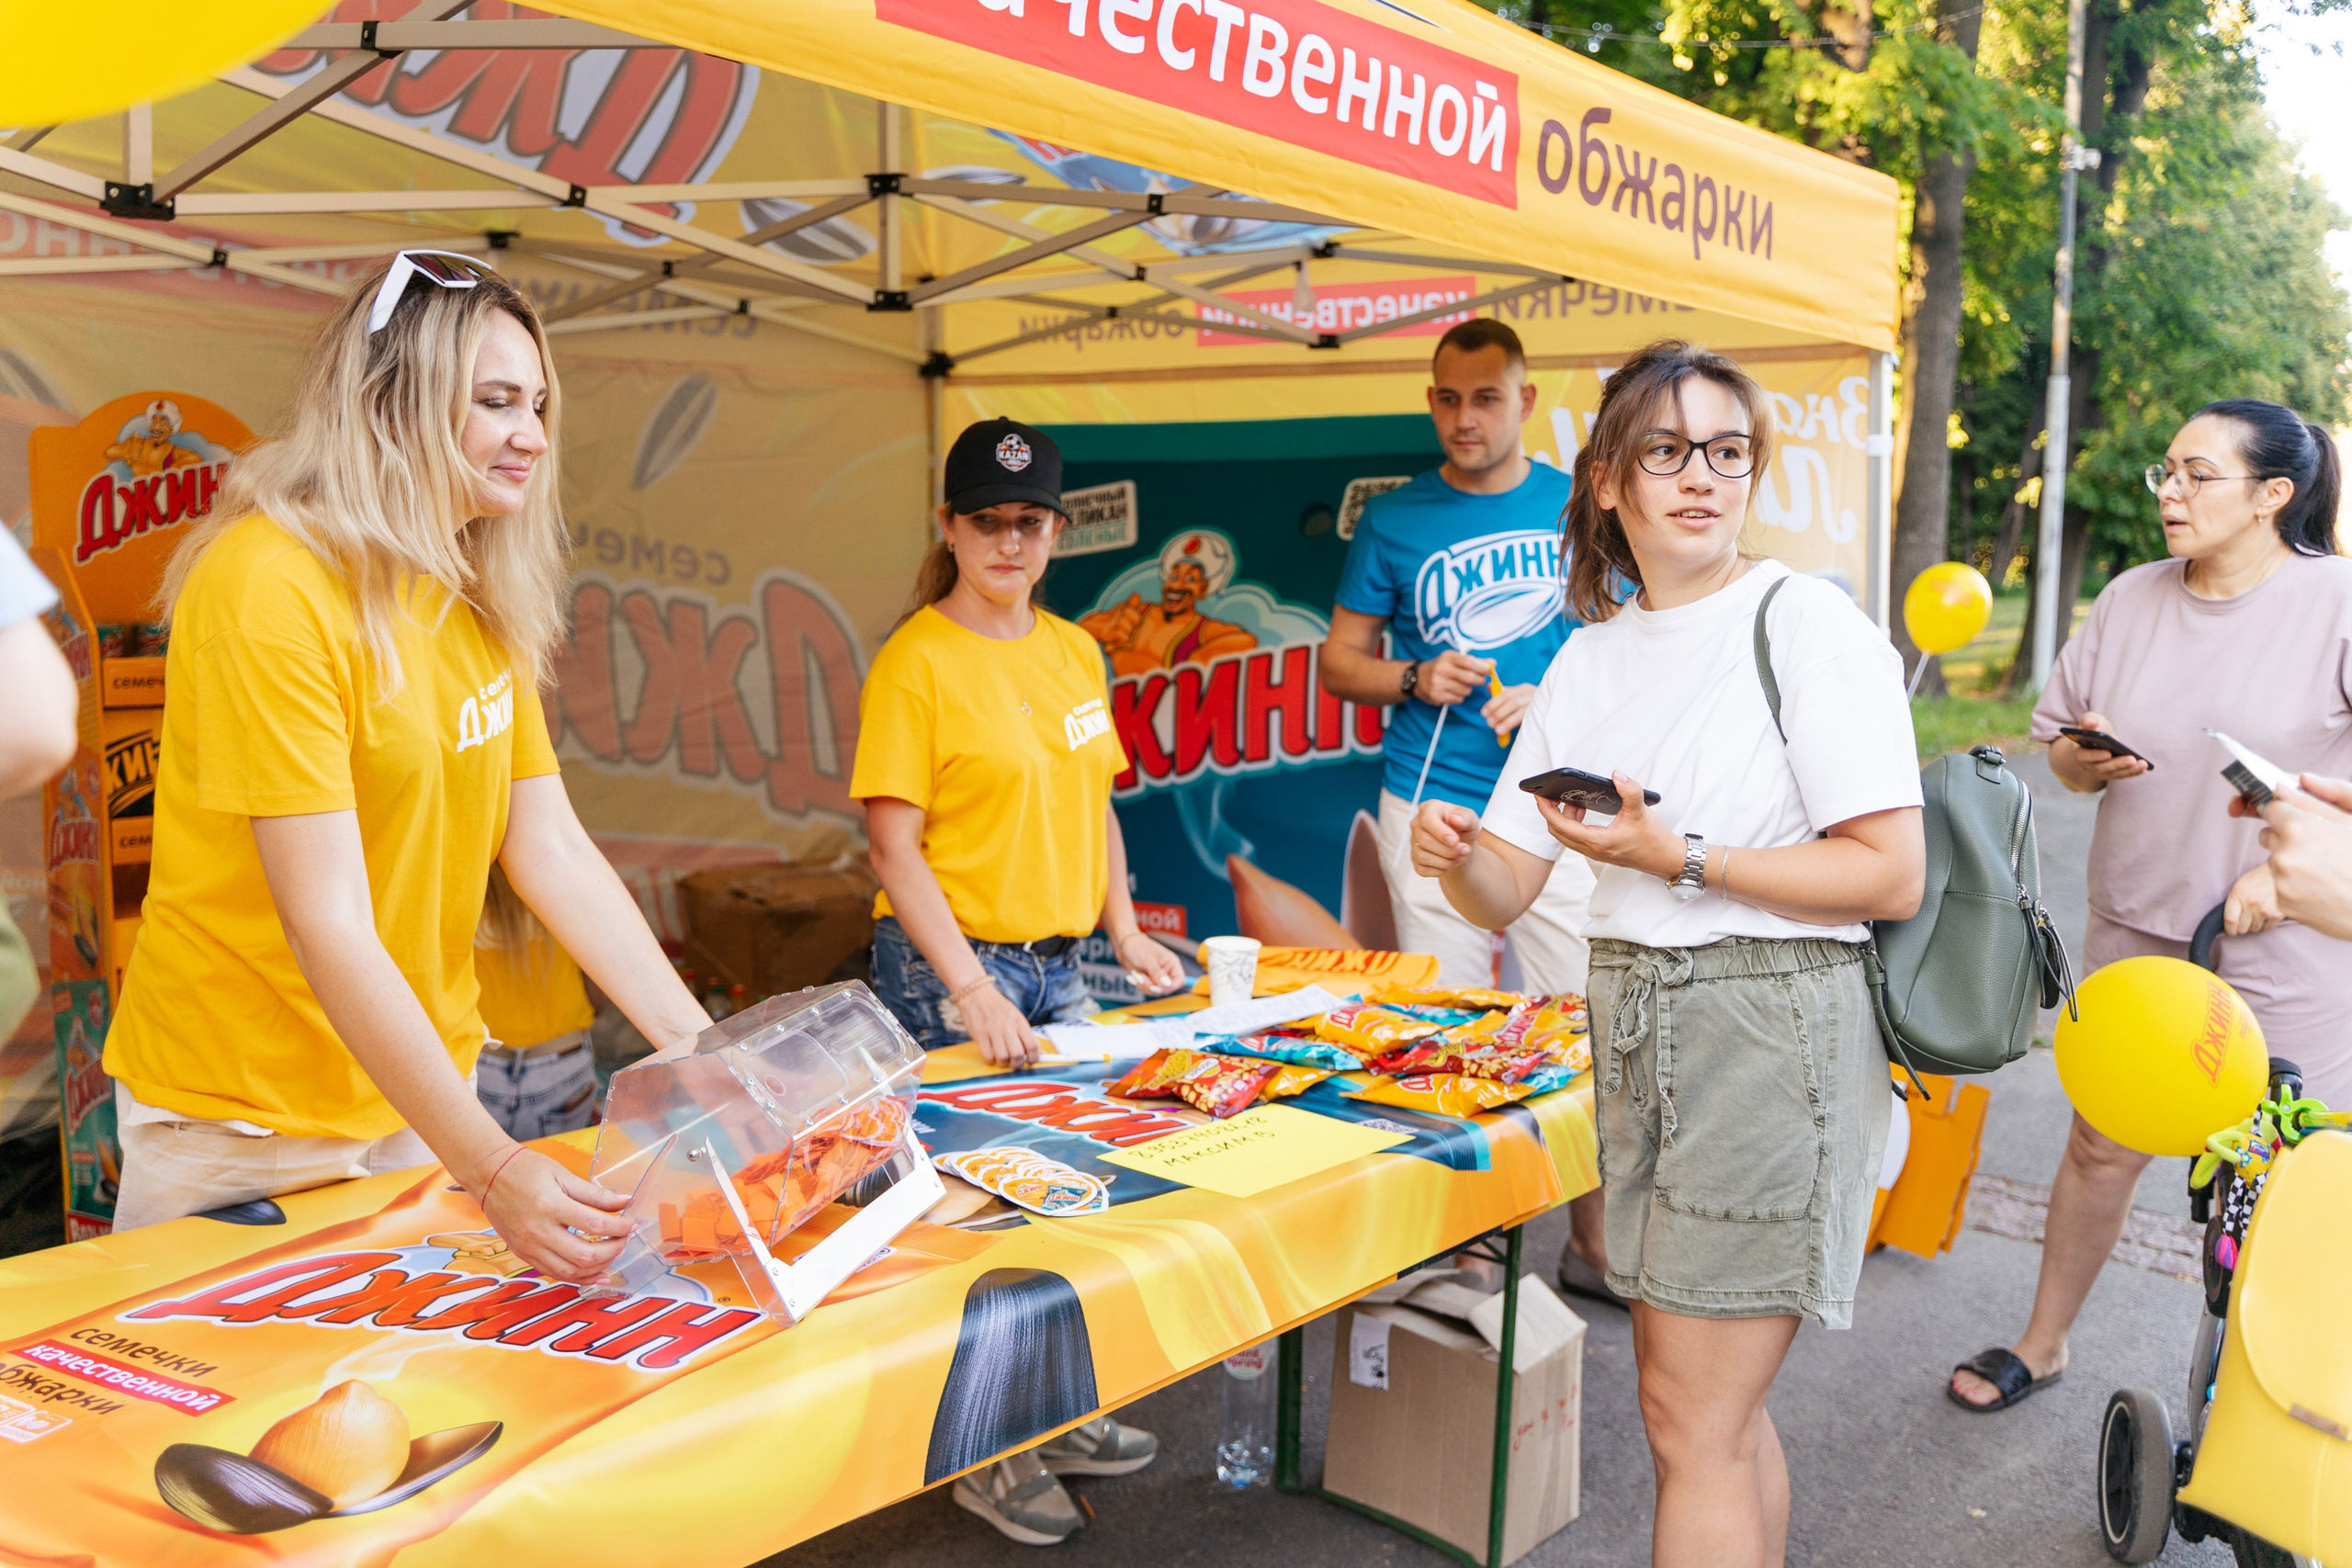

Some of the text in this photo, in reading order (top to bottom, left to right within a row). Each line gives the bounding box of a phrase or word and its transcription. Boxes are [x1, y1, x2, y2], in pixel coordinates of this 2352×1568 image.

[978, 0, 1775, 260] ественной обжарки
[77, 461, 230, 563] Джин
[2193, 979, 2232, 1085] Джинн
[70, 1327, 220, 1379] семечки
[125, 1250, 763, 1369] Джинн
[24, 1343, 222, 1412] качественной
